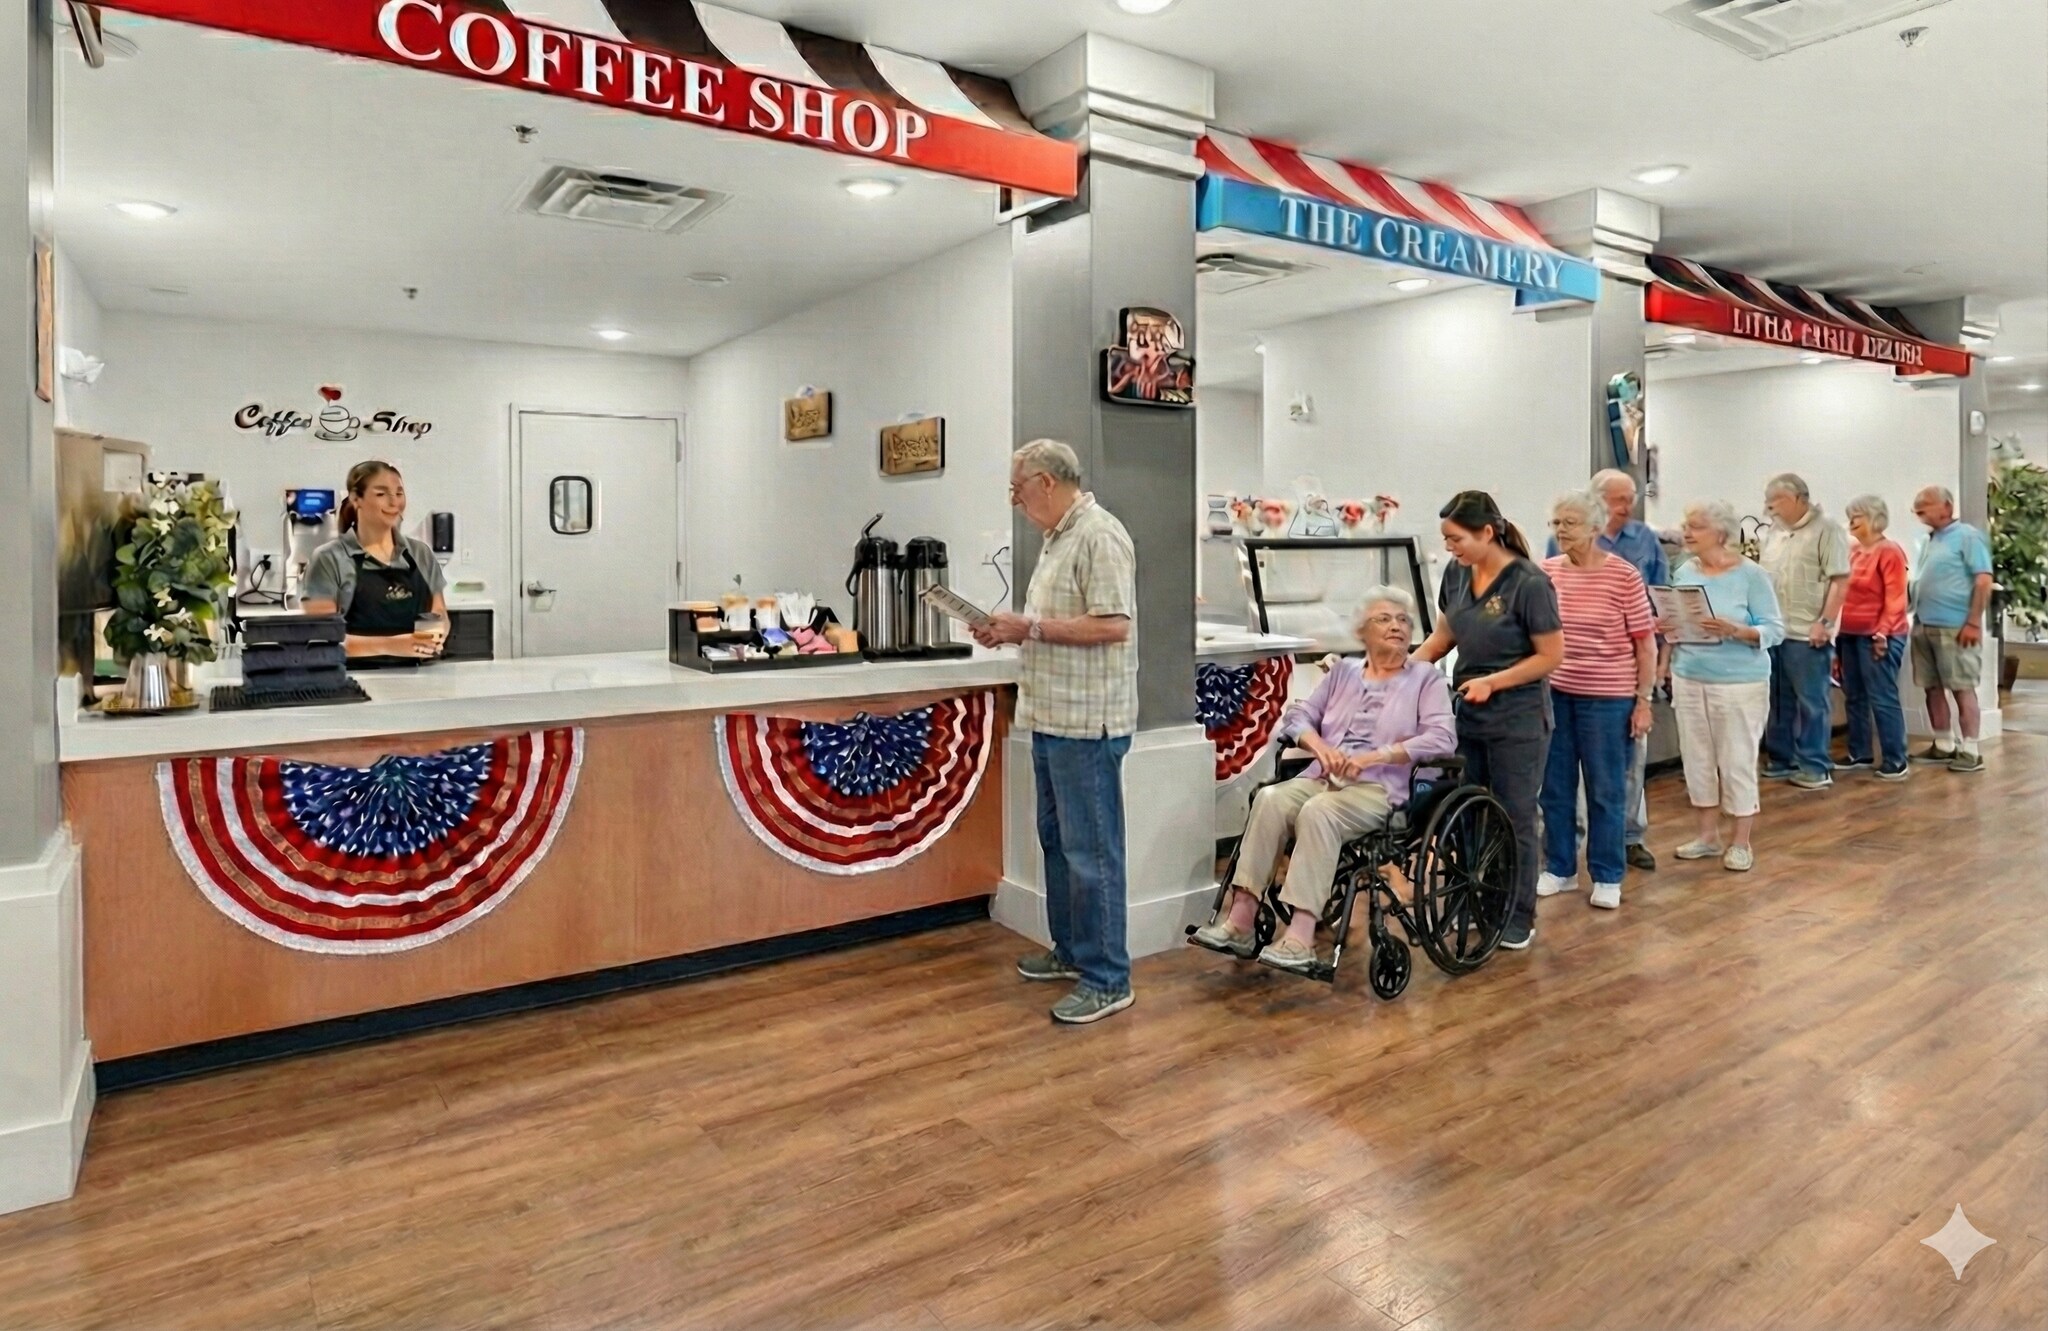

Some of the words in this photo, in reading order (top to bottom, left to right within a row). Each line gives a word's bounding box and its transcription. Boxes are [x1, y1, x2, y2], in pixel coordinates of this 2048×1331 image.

[377, 0, 725, 122] COFFEE
[749, 77, 929, 158] SHOP
[1279, 196, 1362, 247] THE
[1373, 217, 1563, 289] CREAMERY
